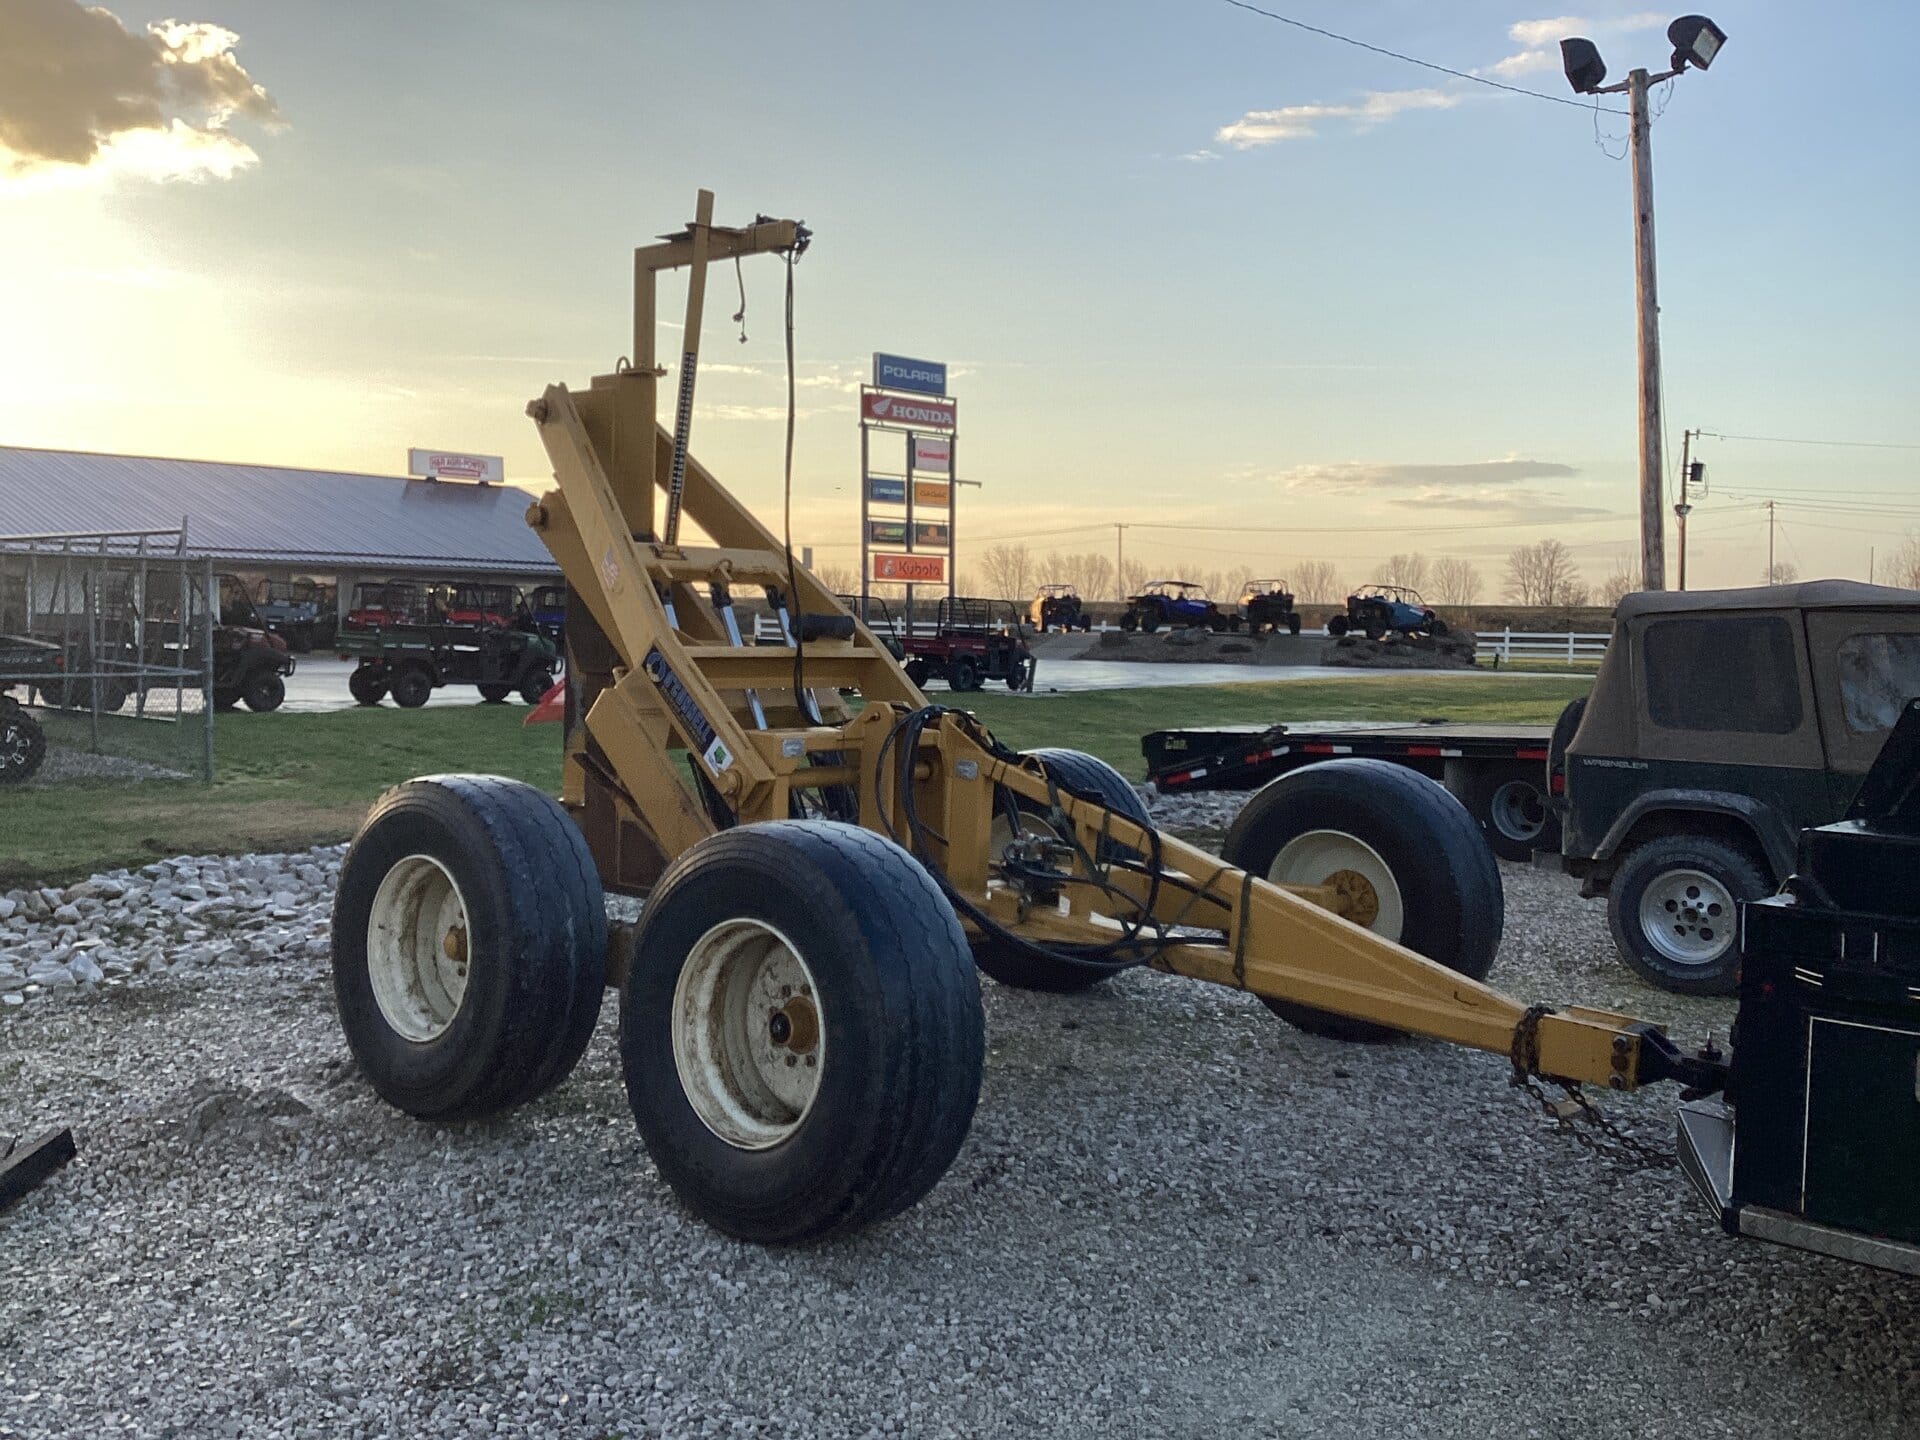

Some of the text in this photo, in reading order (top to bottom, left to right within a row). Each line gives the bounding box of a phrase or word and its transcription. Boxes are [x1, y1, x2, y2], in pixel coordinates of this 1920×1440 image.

[883, 365, 943, 384] POLARIS
[892, 404, 953, 424] HONDA
[898, 560, 940, 577] Kubota
[1582, 758, 1649, 770] WRANGLER
